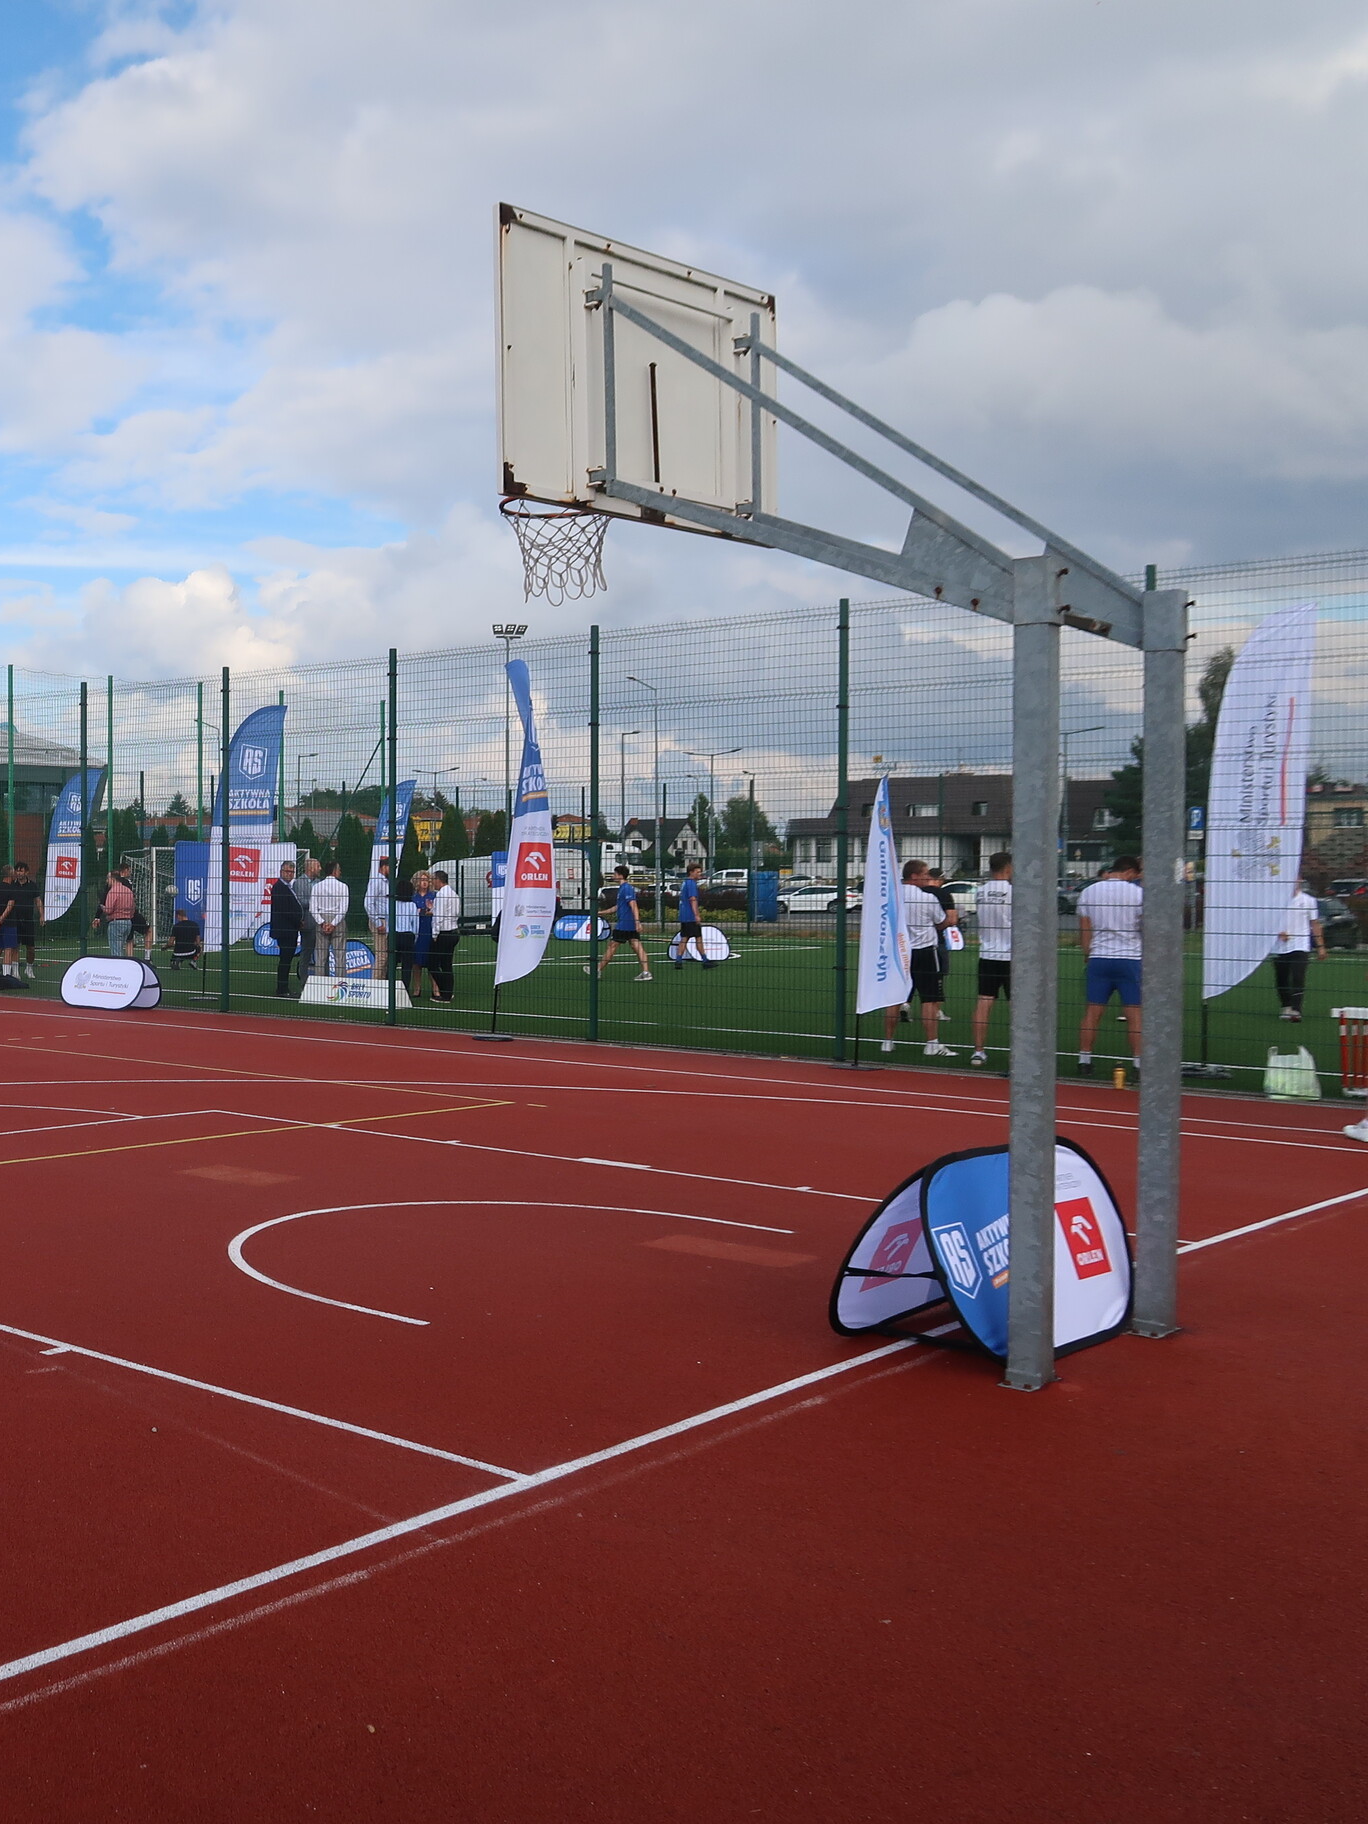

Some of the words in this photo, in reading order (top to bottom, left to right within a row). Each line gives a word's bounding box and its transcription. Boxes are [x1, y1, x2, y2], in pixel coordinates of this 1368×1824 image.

[243, 748, 264, 775] AS
[230, 869, 255, 878] ORLEN
[520, 873, 549, 881] ORLEN
[975, 1213, 1010, 1251] AKTYW
[939, 1230, 977, 1289] AS
